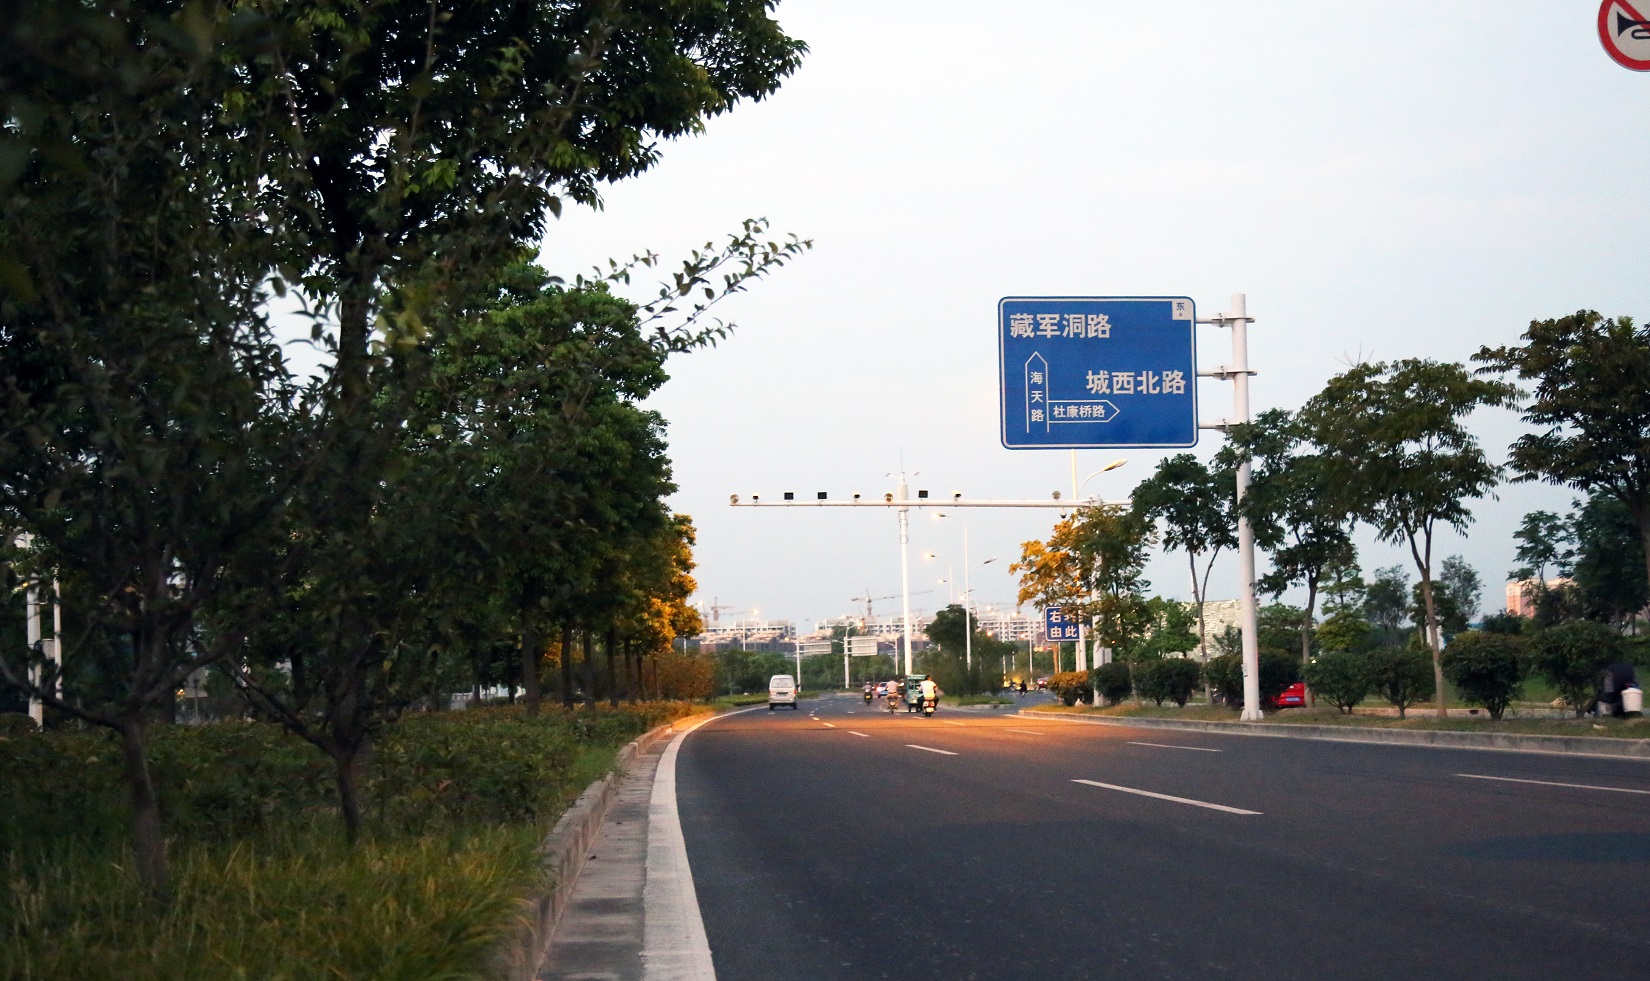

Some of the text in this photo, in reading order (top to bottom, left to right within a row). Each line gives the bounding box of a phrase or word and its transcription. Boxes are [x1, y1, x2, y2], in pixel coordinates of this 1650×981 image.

[1009, 313, 1112, 339] 藏军洞路
[1085, 370, 1186, 395] 城西北路
[1030, 371, 1044, 422] 海天路
[1053, 405, 1105, 418] 杜康桥路
